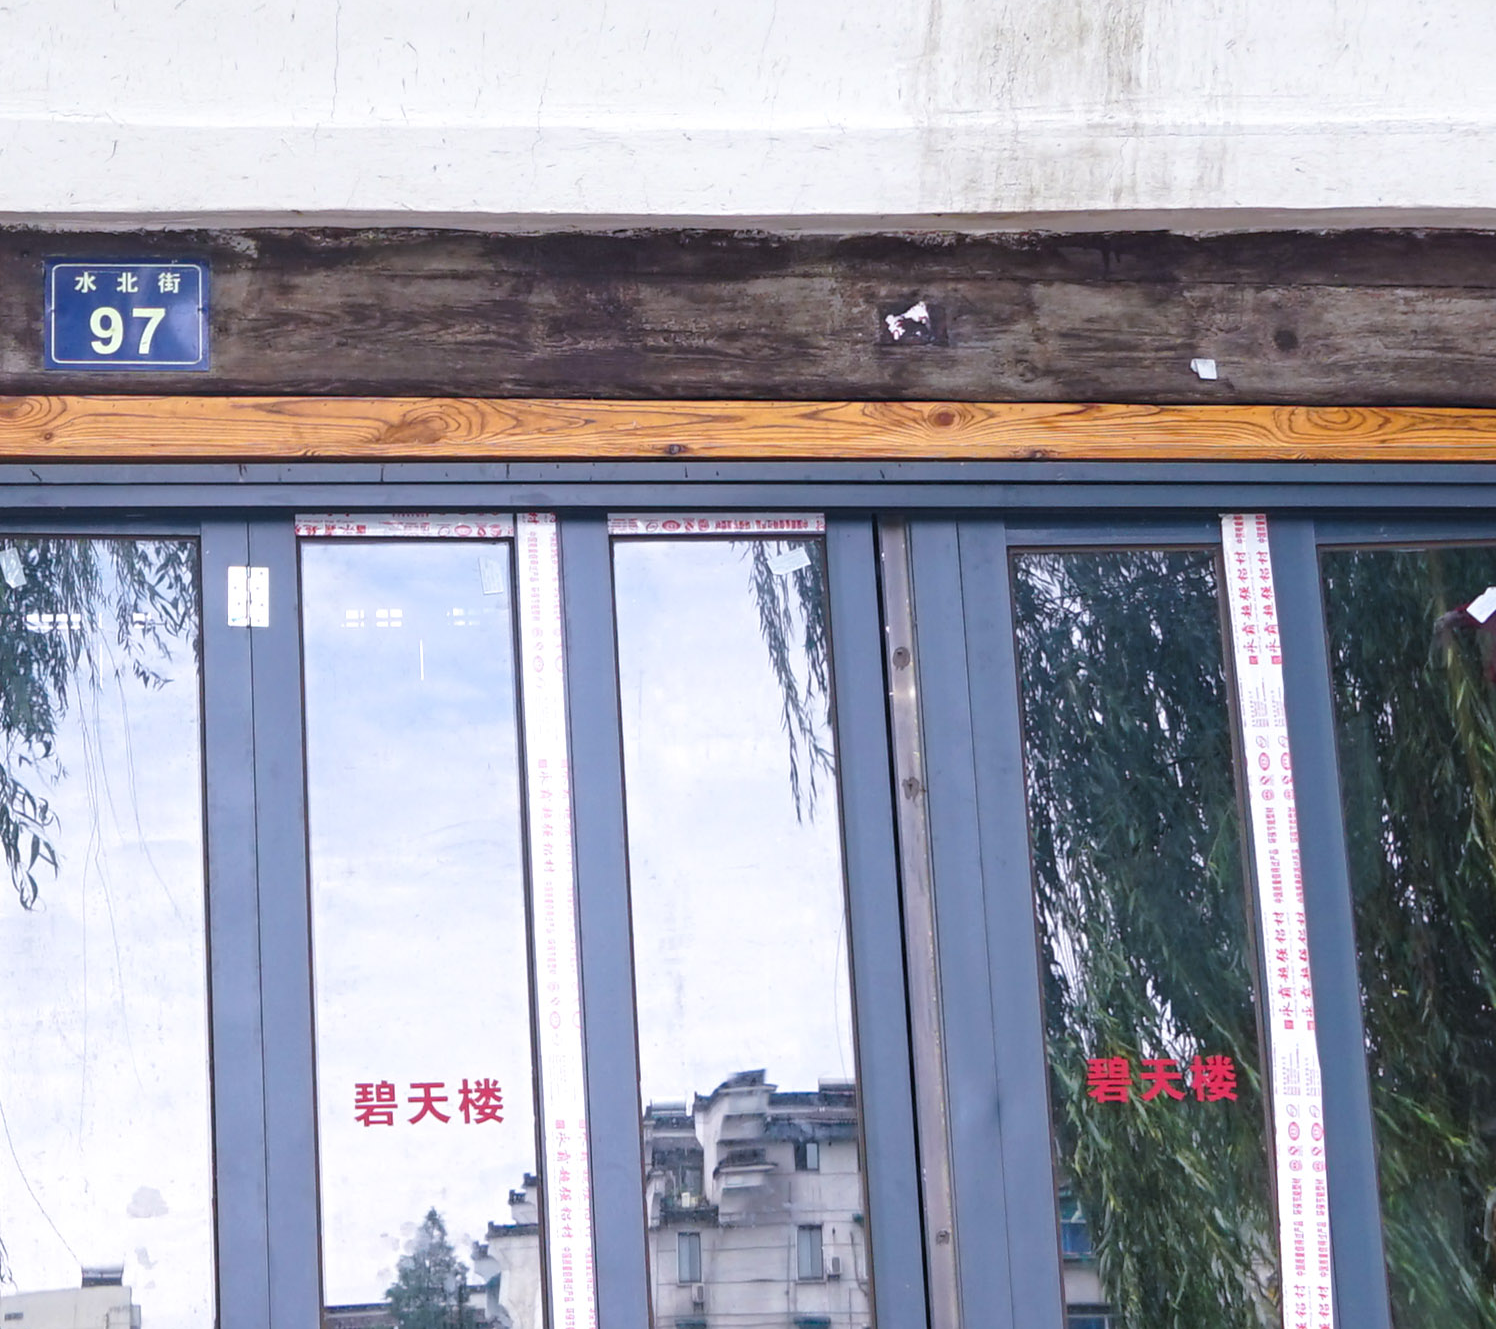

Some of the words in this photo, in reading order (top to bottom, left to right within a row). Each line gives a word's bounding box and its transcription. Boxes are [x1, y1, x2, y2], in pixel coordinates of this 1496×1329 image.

[74, 271, 181, 294] 水北街
[89, 306, 166, 355] 97
[354, 1078, 504, 1127] 碧天楼
[1089, 1057, 1238, 1103] 碧天楼
